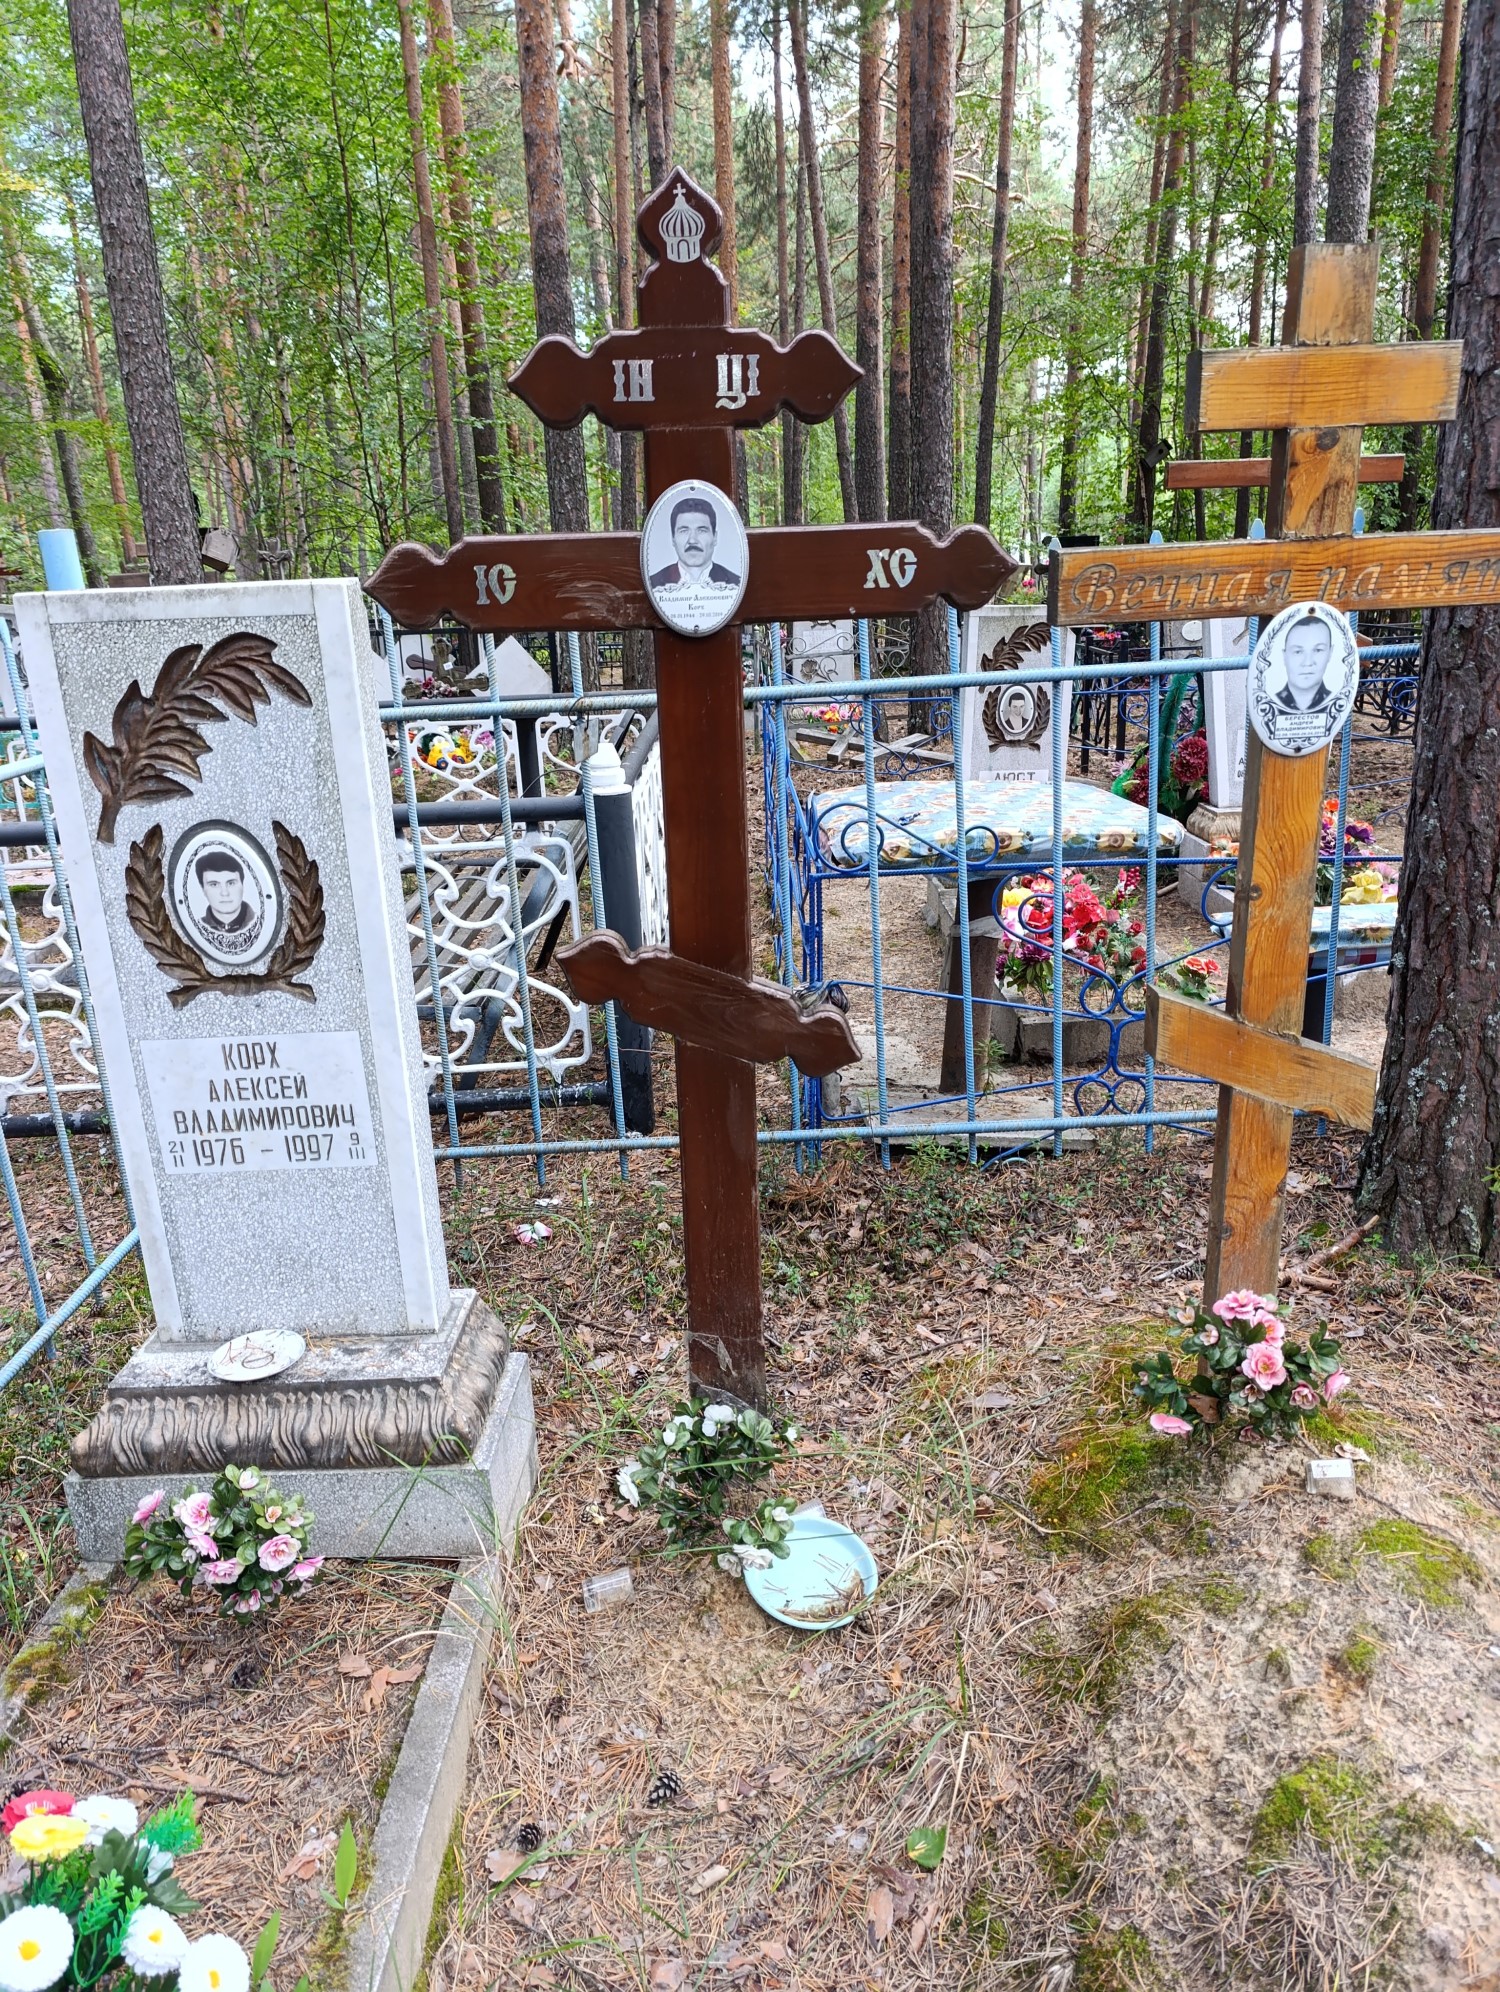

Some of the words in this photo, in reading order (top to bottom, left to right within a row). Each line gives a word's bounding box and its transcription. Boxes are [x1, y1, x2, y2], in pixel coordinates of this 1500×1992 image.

[1071, 562, 1293, 614] Вечная
[221, 1041, 280, 1071] КОРХ
[209, 1072, 308, 1102] АЛЕКСЕЙ
[173, 1103, 356, 1135] ВЛАДИМИРОВИЧ
[192, 1137, 245, 1167] 1976
[284, 1133, 334, 1163] 1997
